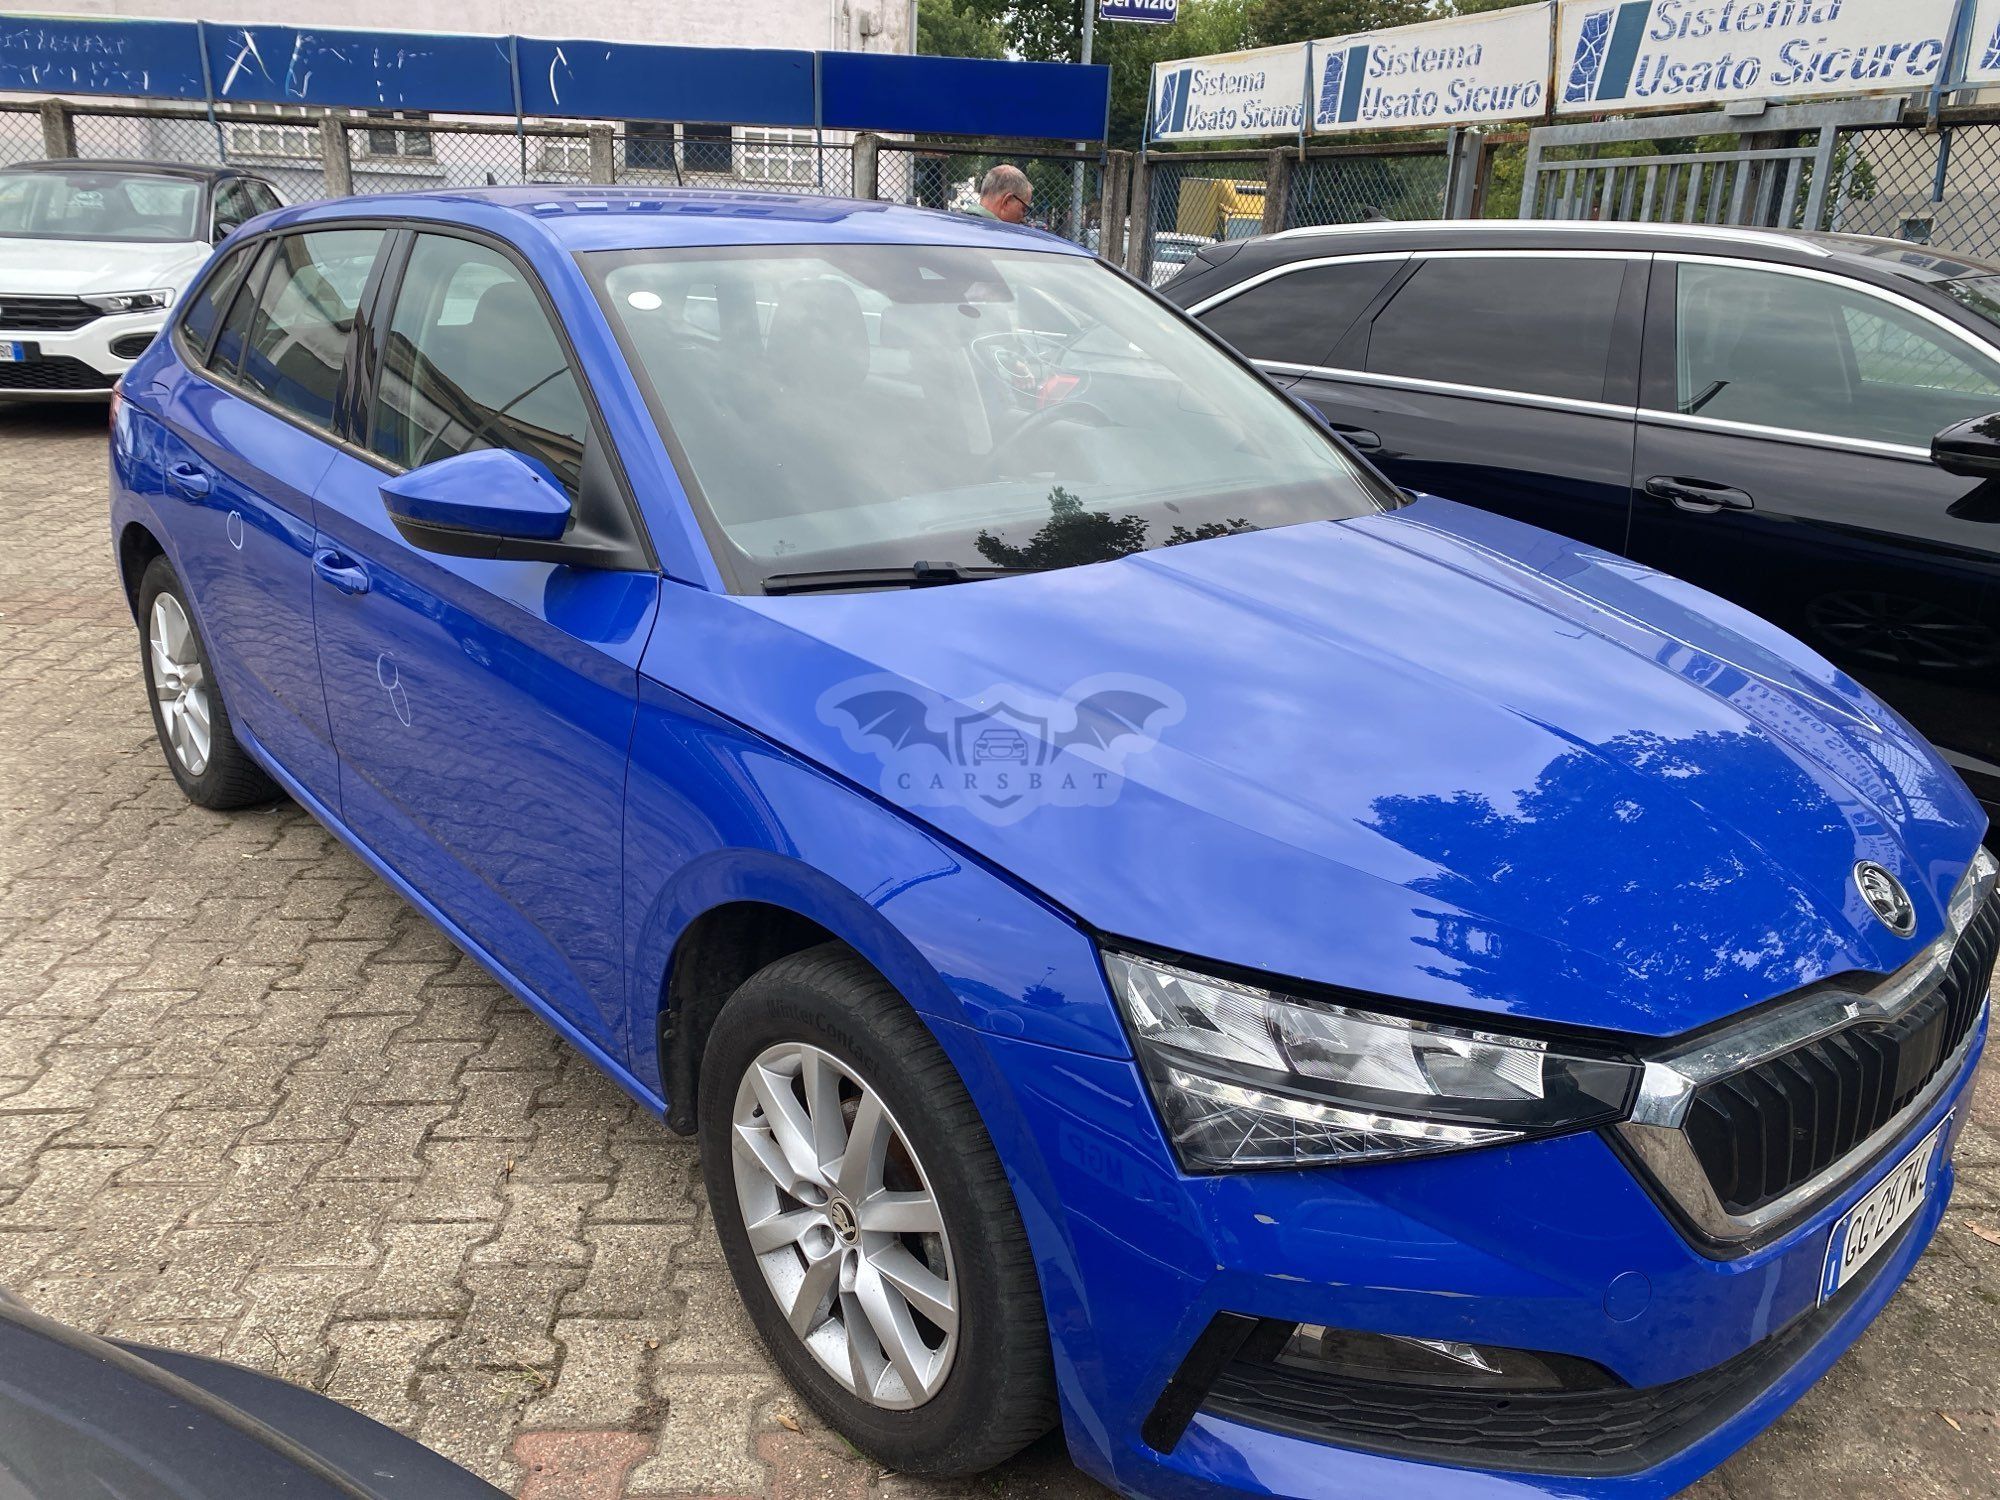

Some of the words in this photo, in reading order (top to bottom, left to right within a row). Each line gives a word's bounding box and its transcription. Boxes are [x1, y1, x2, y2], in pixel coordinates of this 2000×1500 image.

[1650, 0, 1843, 41] Sistema
[1369, 44, 1483, 78] Sistema
[1634, 50, 1762, 97] Usato
[1770, 36, 1943, 86] Sicuro
[1192, 69, 1266, 96] Sistema
[1363, 86, 1438, 121] Usato
[1444, 77, 1542, 115] Sicuro
[1186, 103, 1237, 132] Usato
[1240, 98, 1303, 130] Sicuro
[1845, 1203, 1875, 1267] GG
